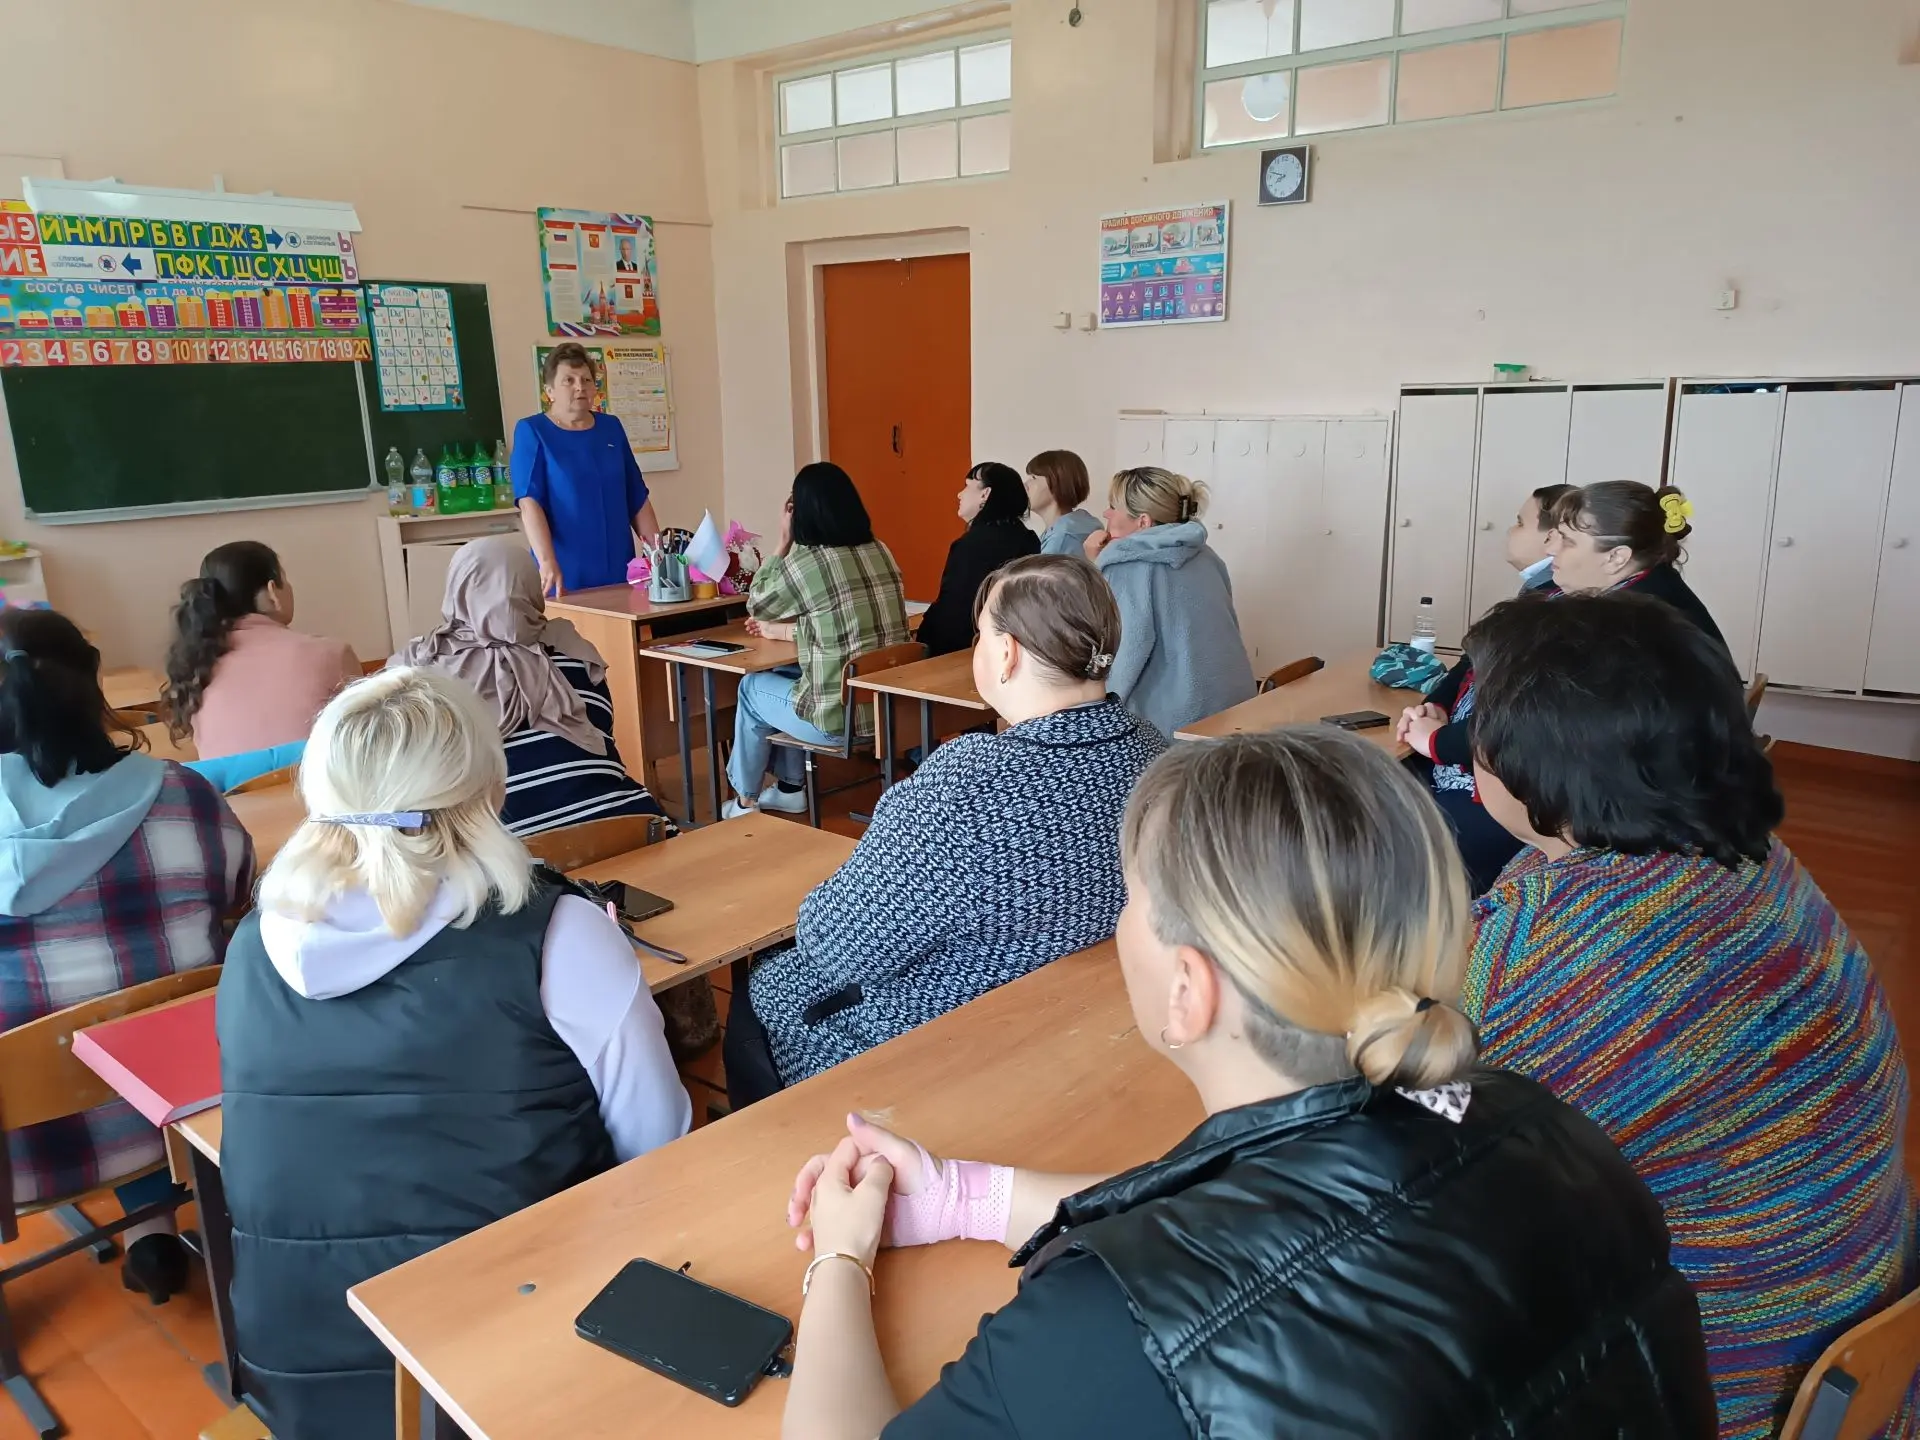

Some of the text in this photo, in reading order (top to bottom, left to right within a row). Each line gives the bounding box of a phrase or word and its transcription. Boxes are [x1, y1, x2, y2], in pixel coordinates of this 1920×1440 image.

[1130, 211, 1170, 225] ДОРОЖНОГО
[25, 282, 85, 294] СОСТАВ
[88, 283, 136, 295] ЧИСЕЛ
[161, 286, 168, 295] 1
[171, 288, 187, 297] до
[191, 286, 204, 297] 10
[2, 339, 370, 364] 2 3 4 5 6 7 8 9 10 11 12 13 14 15 16 17 18 19 20
